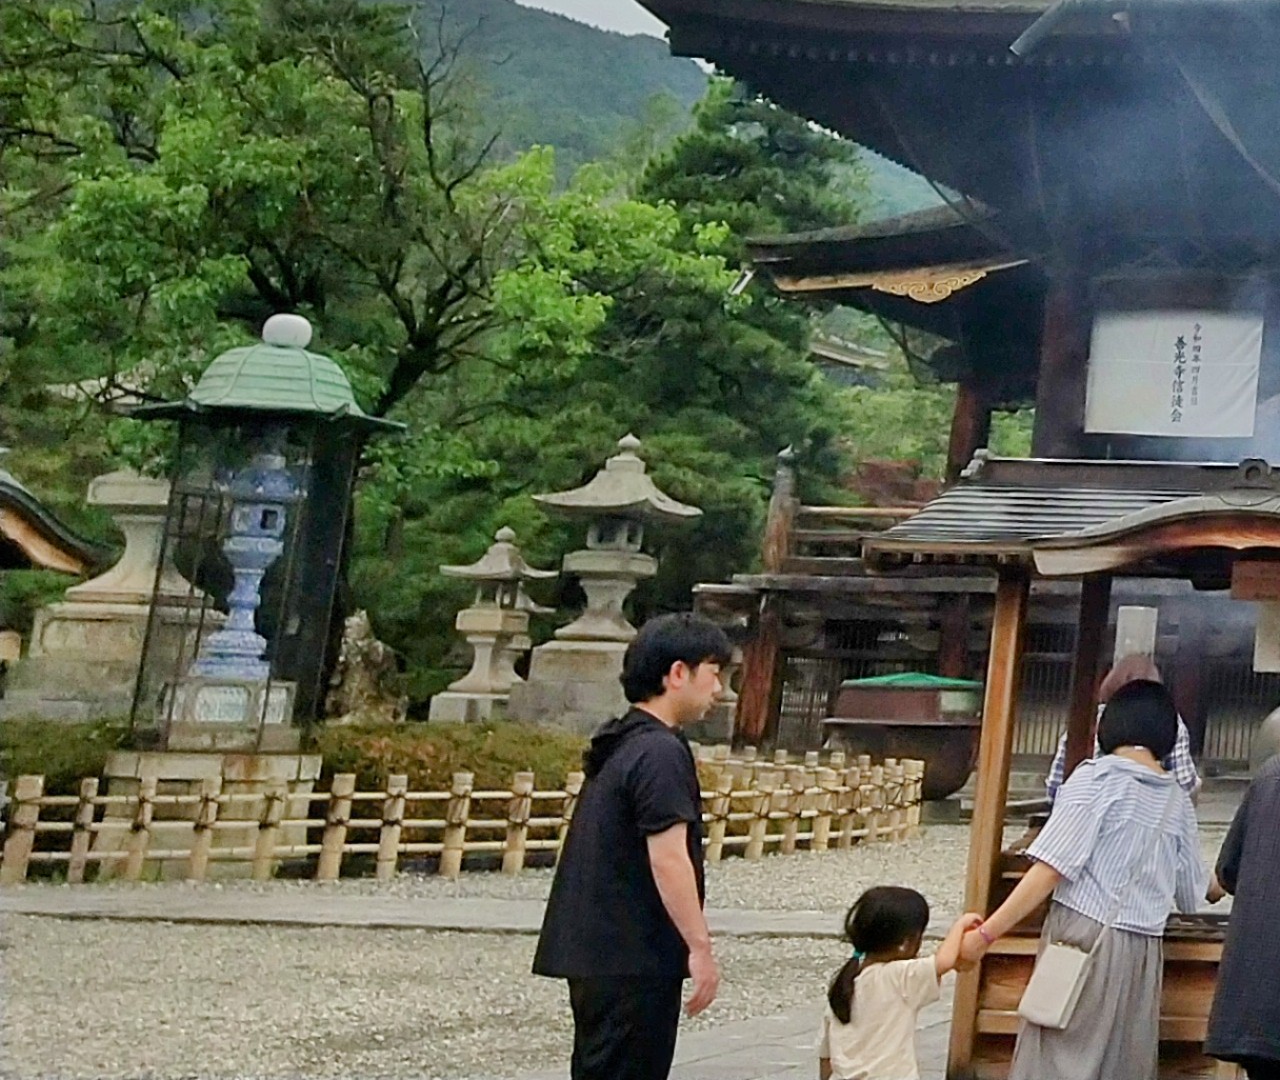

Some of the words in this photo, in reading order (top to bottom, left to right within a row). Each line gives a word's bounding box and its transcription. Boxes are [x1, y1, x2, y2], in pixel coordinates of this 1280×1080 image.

[1171, 335, 1188, 423] 善光寺信徒会
